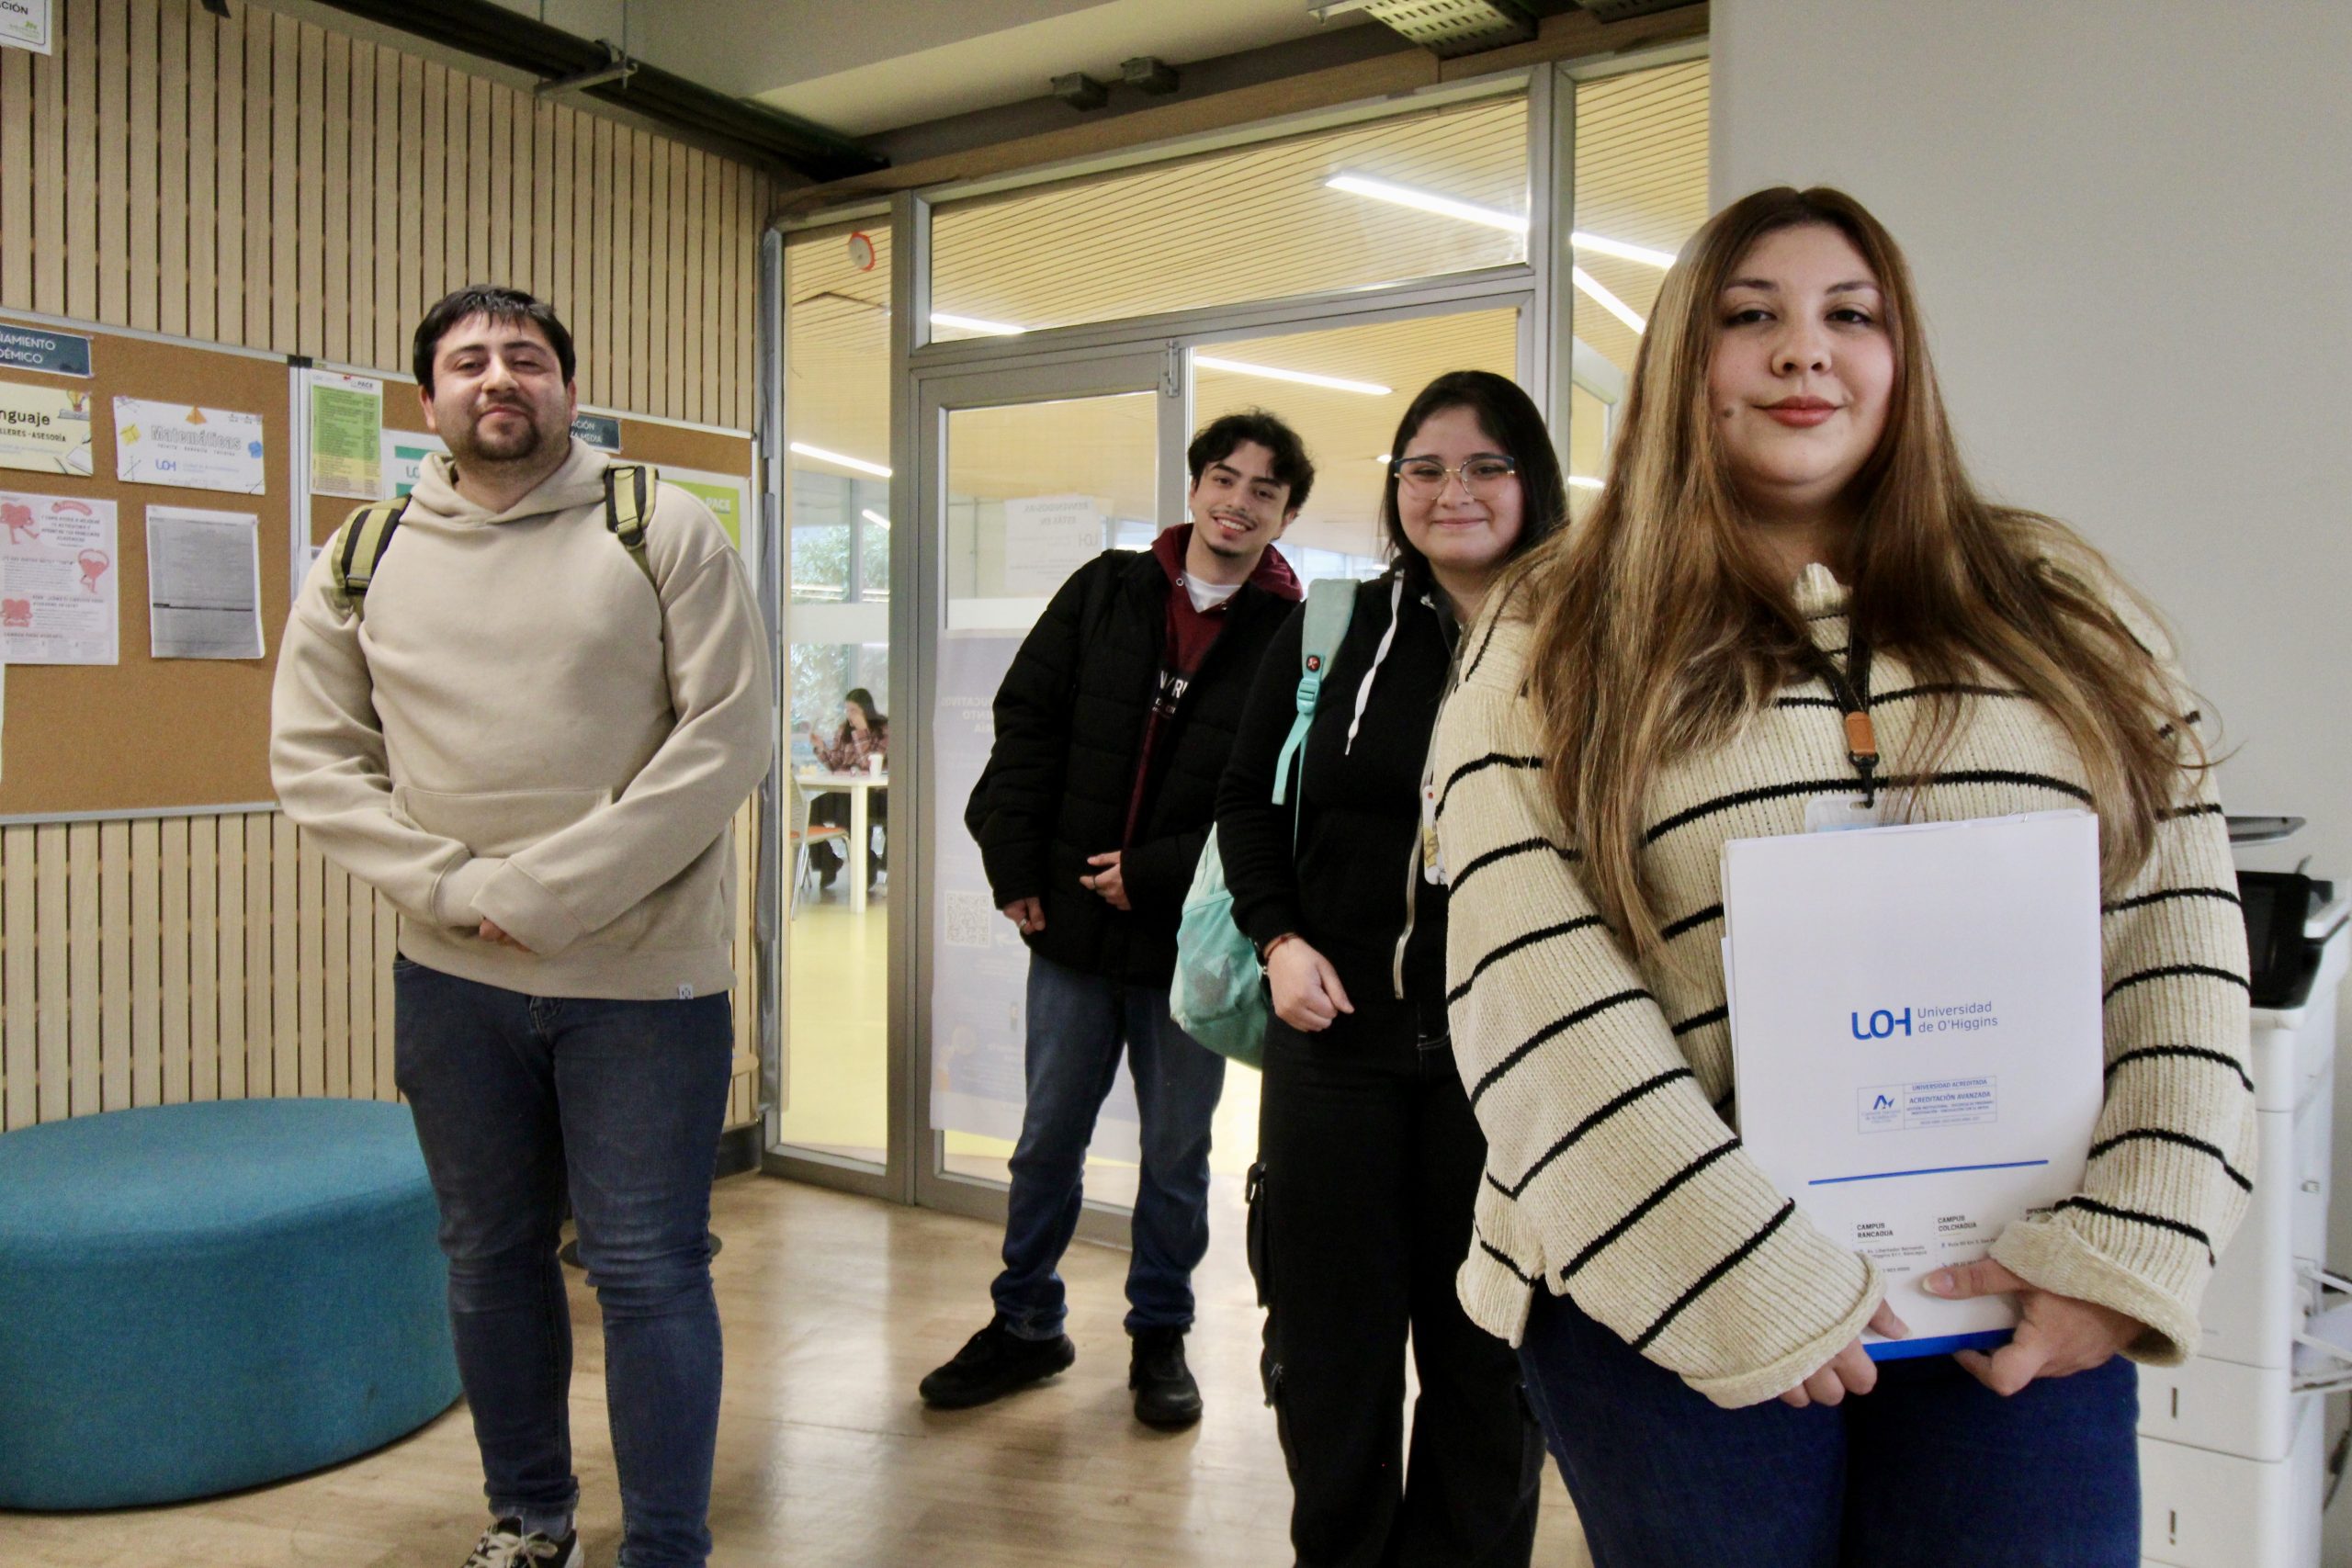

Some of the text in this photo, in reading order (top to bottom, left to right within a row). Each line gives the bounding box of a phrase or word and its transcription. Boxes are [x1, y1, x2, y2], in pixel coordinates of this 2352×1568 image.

[0, 1, 28, 15] CIÓN
[1917, 1000, 1993, 1019] Universidad
[1918, 1016, 1998, 1033] de O'Higgins
[1912, 1079, 1987, 1091] UNIVERSIDAD ACREDITADA
[1909, 1090, 1991, 1104] ACREDITACIÓN AVANZADA
[1938, 1215, 1965, 1224] CAMPUS
[1857, 1223, 1885, 1231] CAMPUS
